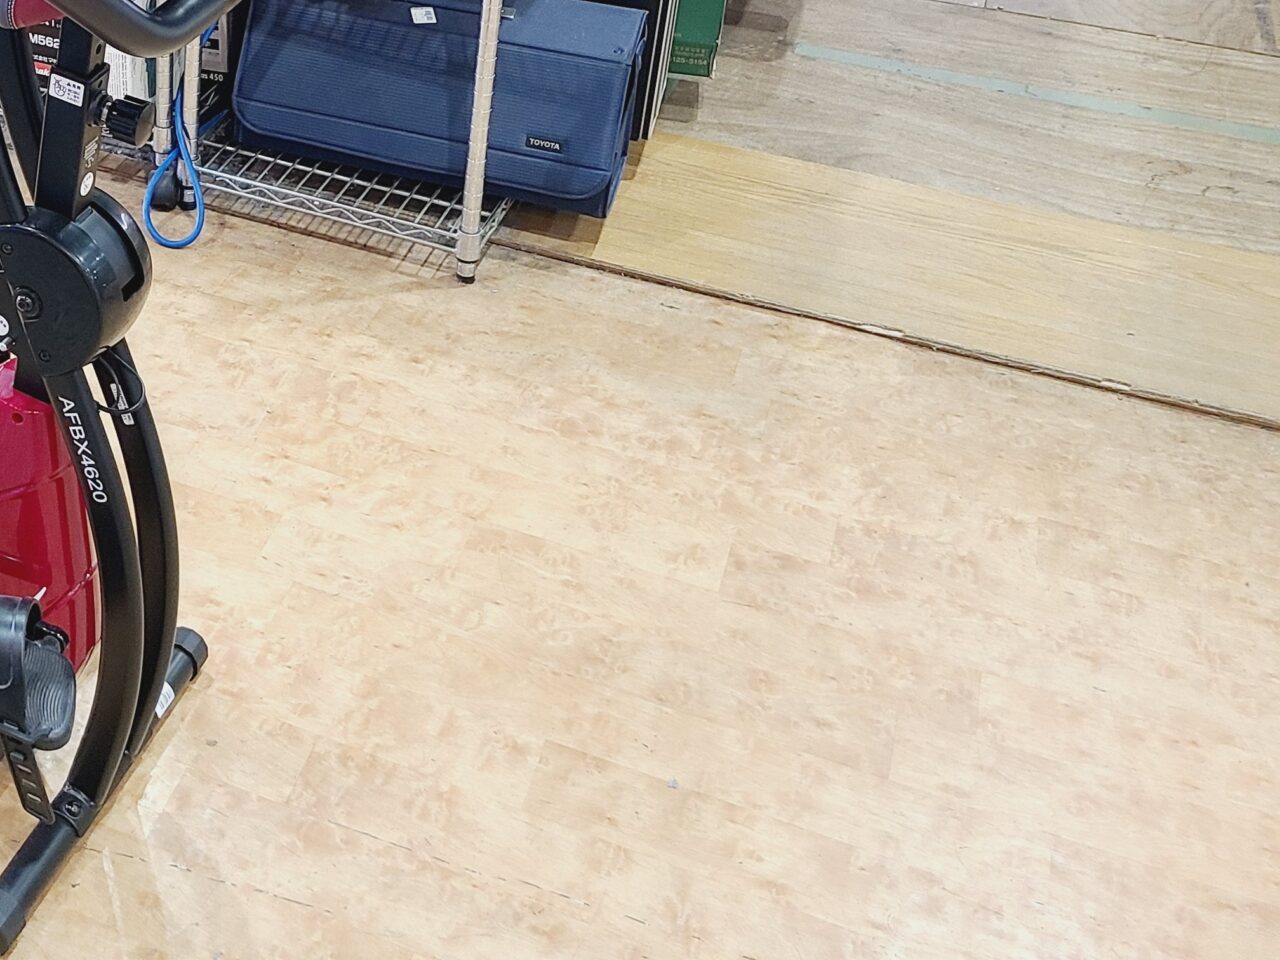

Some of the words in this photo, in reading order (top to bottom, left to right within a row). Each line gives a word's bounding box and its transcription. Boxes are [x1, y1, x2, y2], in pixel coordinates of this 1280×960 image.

[209, 73, 224, 82] 450
[529, 137, 560, 150] TOYOTA
[57, 396, 108, 504] AFBX4620
